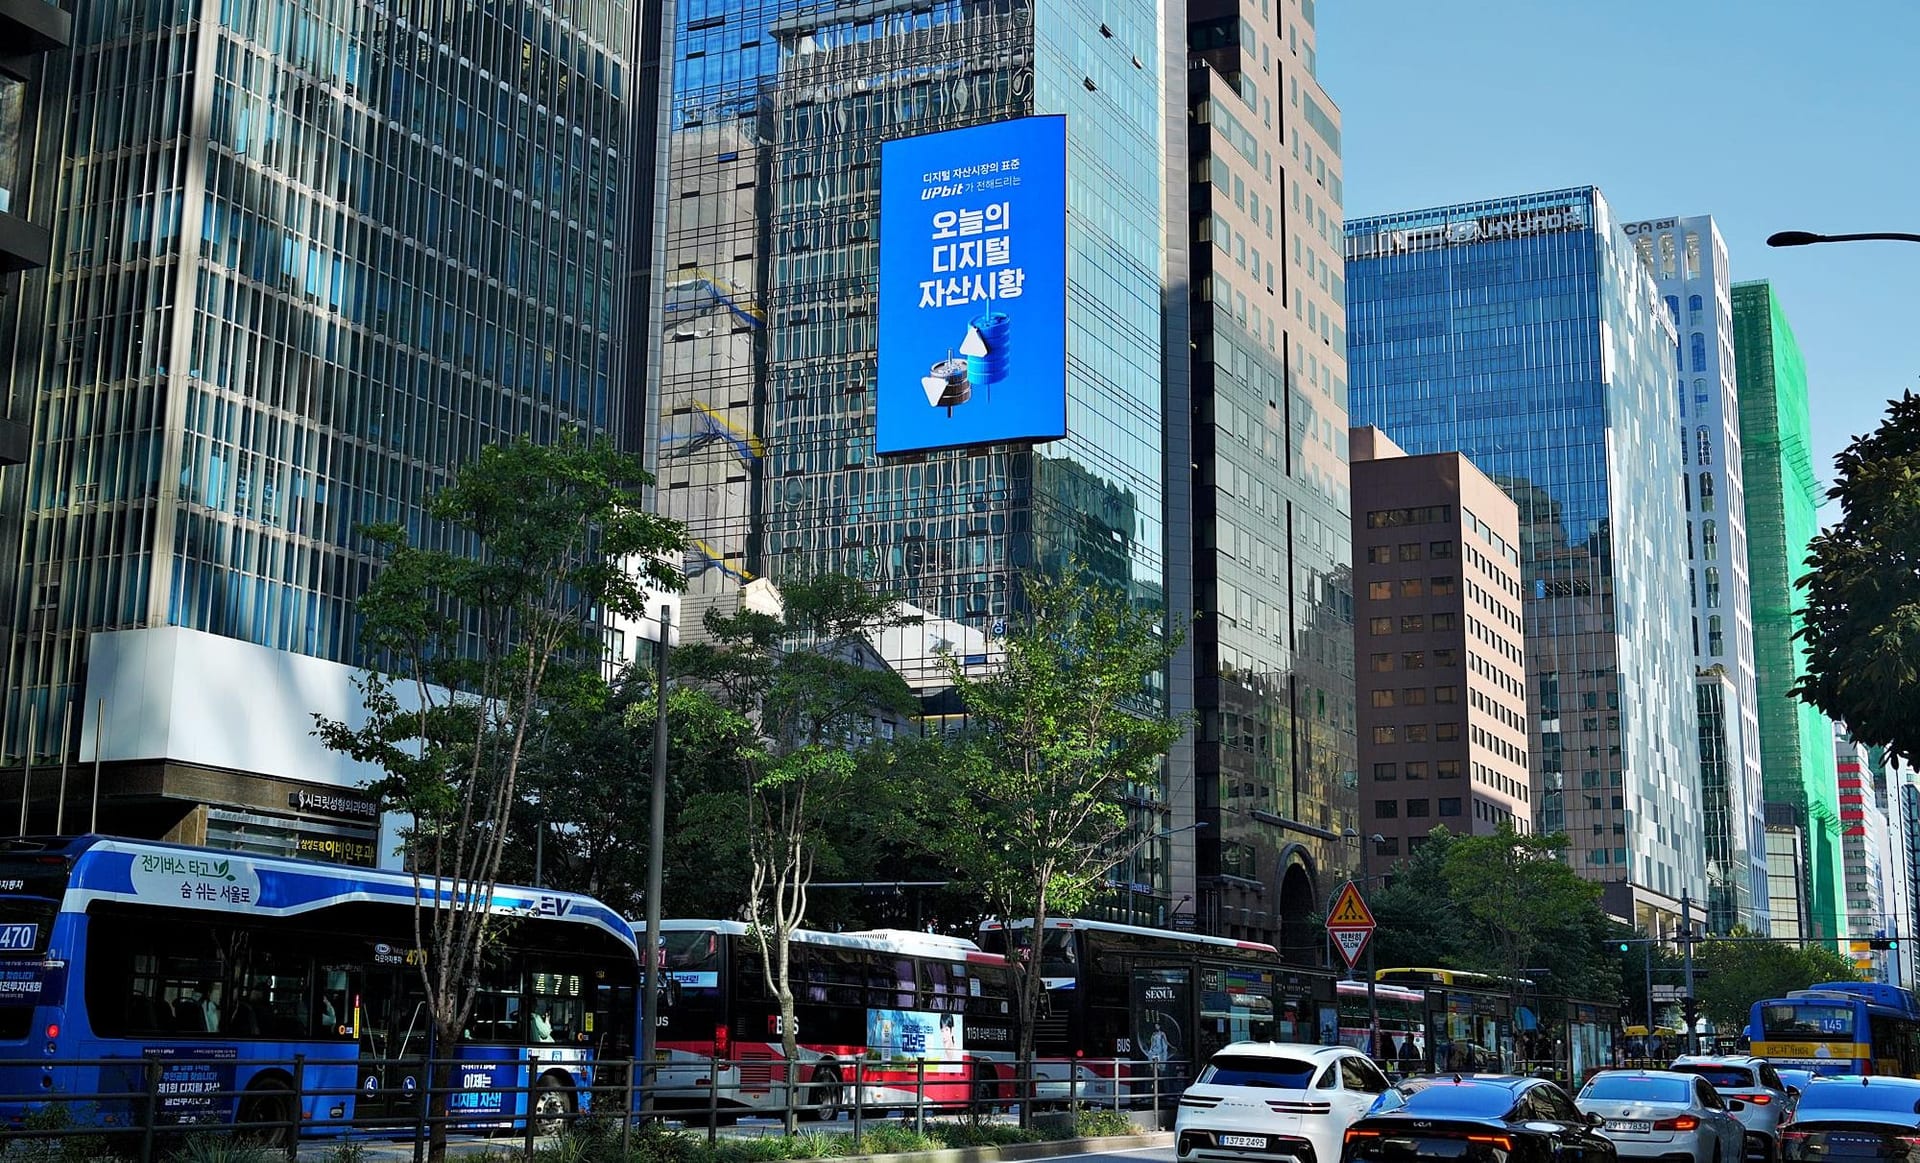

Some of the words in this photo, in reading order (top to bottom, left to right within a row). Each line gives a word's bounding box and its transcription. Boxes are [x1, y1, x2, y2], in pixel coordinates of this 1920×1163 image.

[923, 170, 950, 183] 디지털
[953, 162, 999, 179] 자산시장의
[1001, 158, 1020, 171] 표준
[965, 182, 974, 192] 가
[976, 176, 1021, 191] 전해드리는
[932, 201, 1010, 240] 오늘의
[932, 235, 1010, 273] 디지털
[918, 268, 1026, 308] 자산시황
[304, 793, 377, 816] 시크릿성형외과의원
[142, 855, 185, 875] 전기버스
[188, 860, 209, 877] 타고
[0, 880, 24, 890] 자동차
[181, 881, 192, 899] 숨
[195, 883, 217, 901] 쉬는
[220, 885, 251, 904] 서울로
[538, 896, 571, 917] EV
[0, 926, 32, 948] 470
[536, 973, 580, 997] 470
[655, 1015, 669, 1027] US
[767, 1015, 799, 1035] RBS
[1823, 1019, 1843, 1031] 145
[966, 1026, 980, 1041] 1151
[463, 1073, 492, 1089] 이제는
[451, 1092, 478, 1107] 디지털
[480, 1092, 502, 1107] 자산!
[1246, 1137, 1265, 1148] 2495
